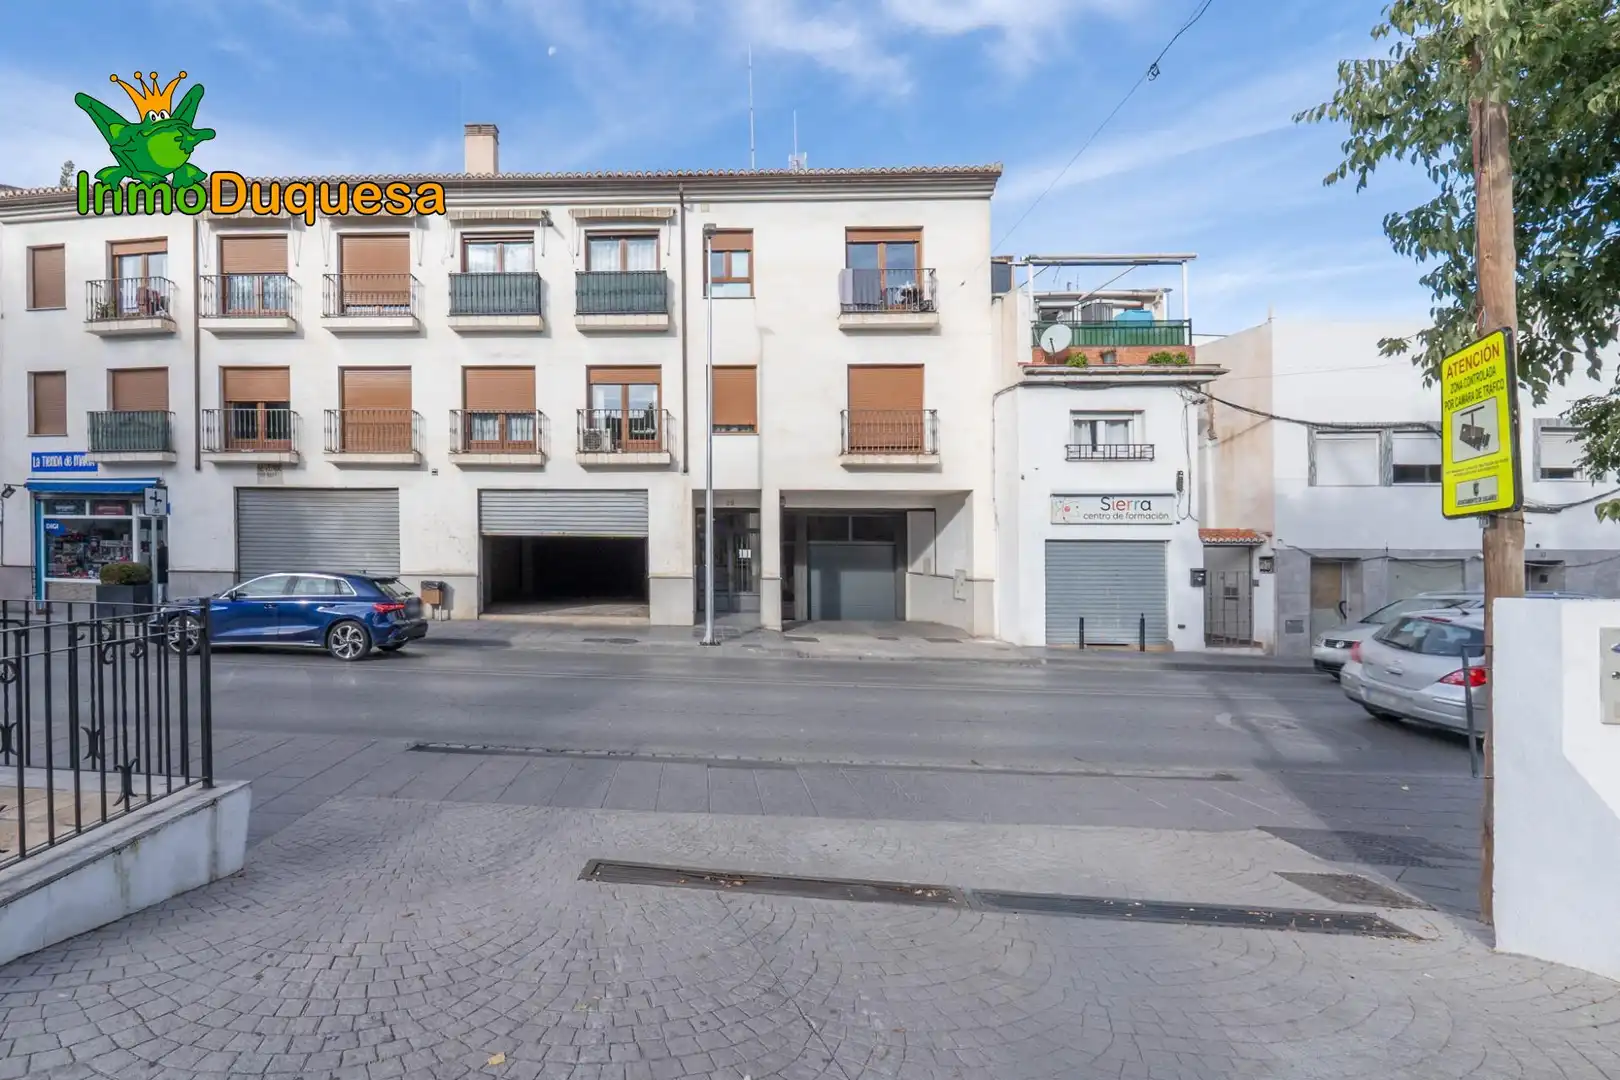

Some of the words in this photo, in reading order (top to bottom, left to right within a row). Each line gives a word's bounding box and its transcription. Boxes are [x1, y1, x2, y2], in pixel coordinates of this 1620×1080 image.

[1446, 341, 1500, 380] ATENCIÓN
[1450, 380, 1463, 395] ZONA
[1463, 365, 1497, 388] CONTROLADA
[1444, 399, 1455, 411] POR
[1475, 387, 1483, 400] DE
[32, 455, 41, 468] La
[1100, 496, 1152, 511] Sierra
[1083, 511, 1111, 520] centro
[1112, 511, 1124, 520] de
[1125, 511, 1169, 520] formación
